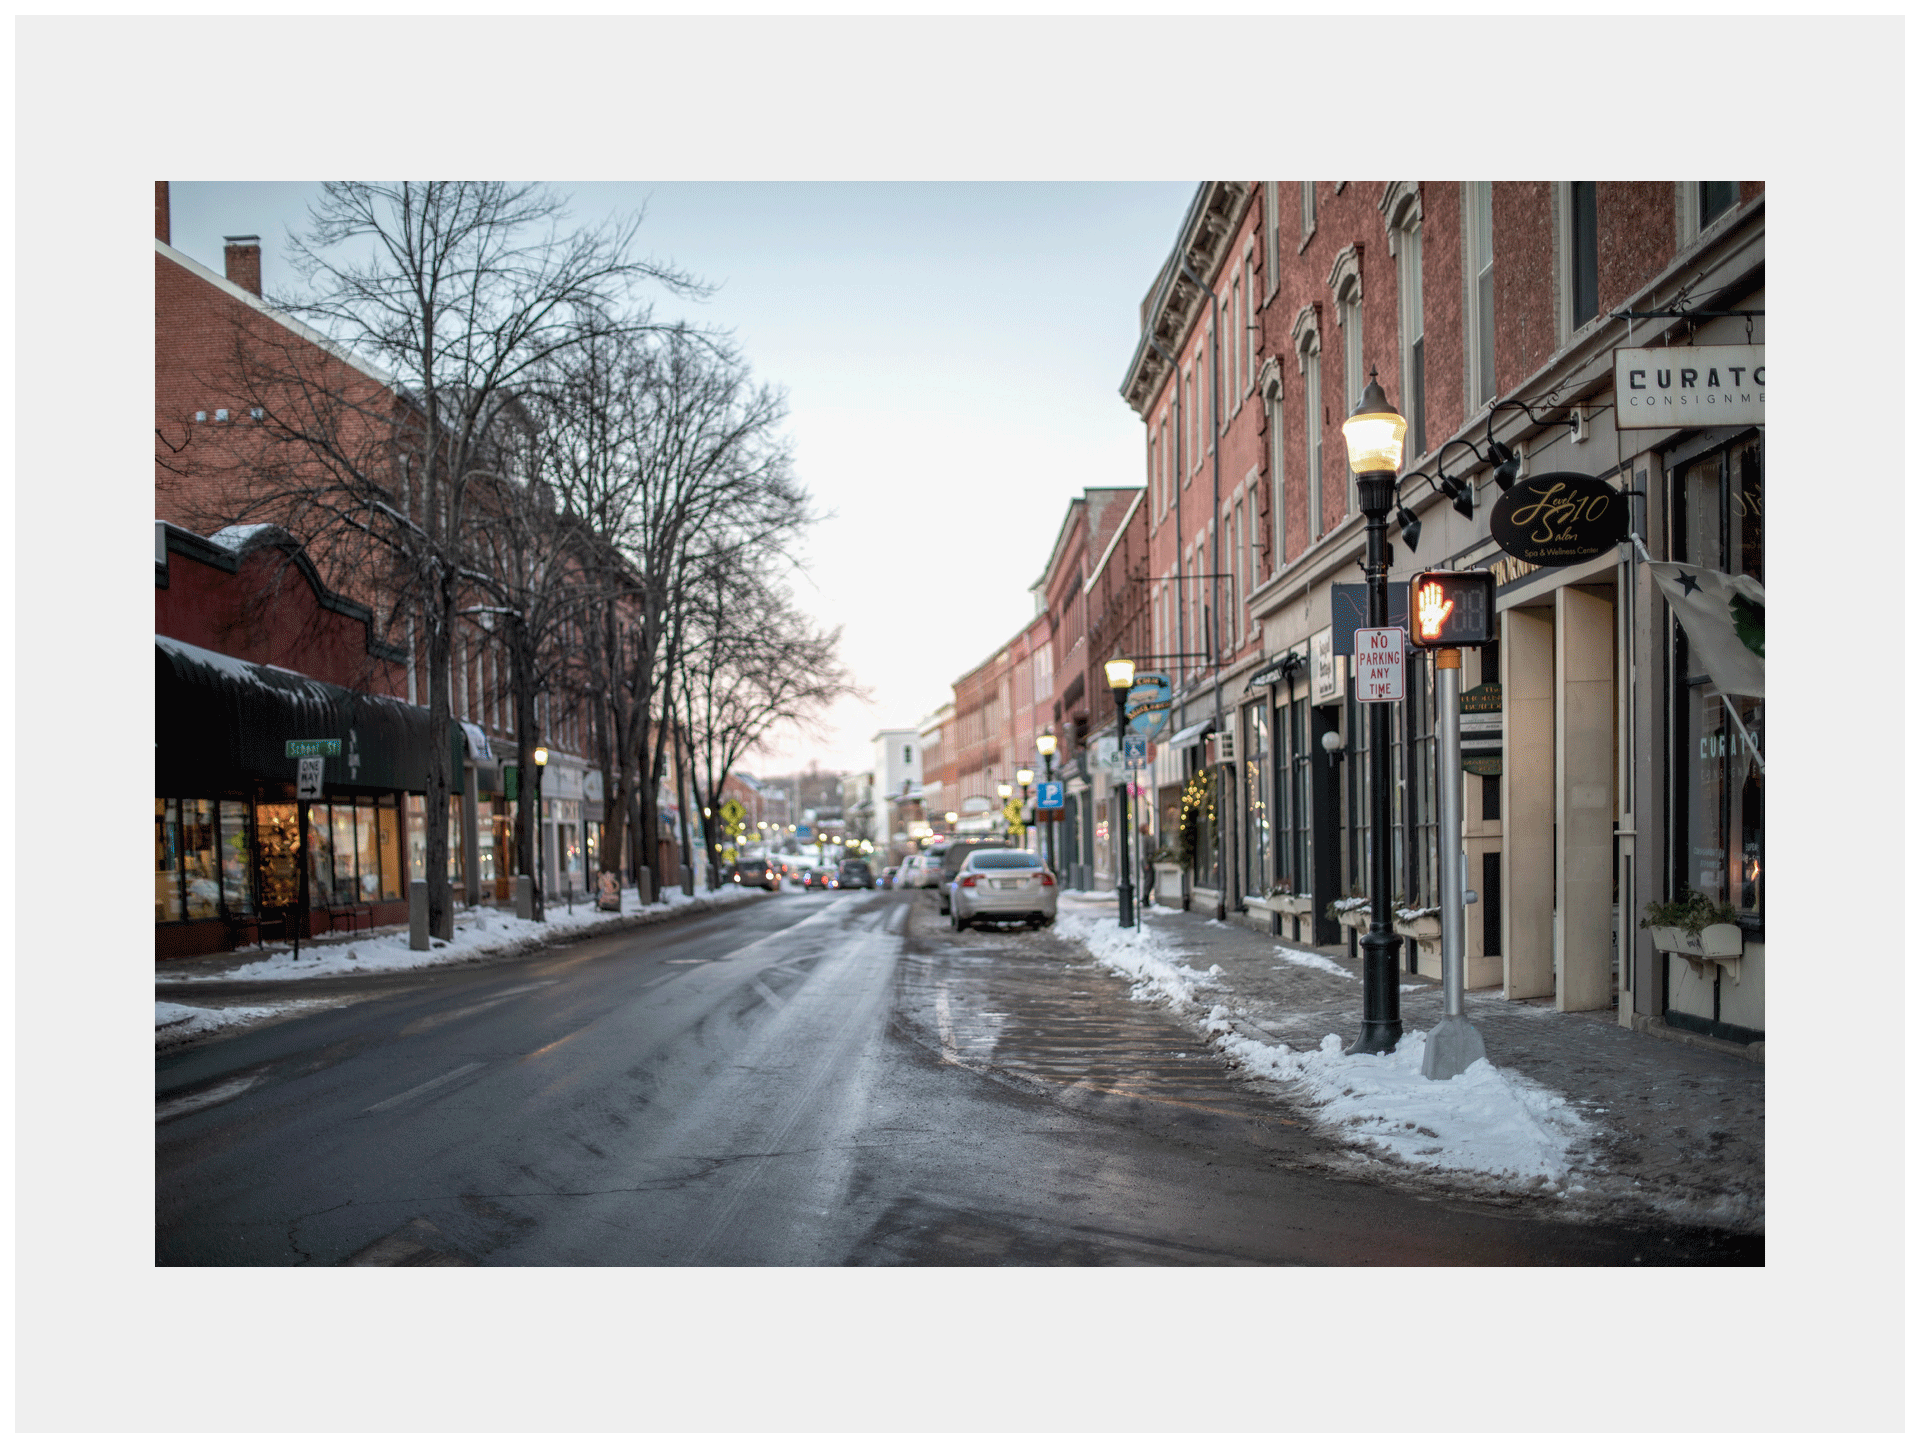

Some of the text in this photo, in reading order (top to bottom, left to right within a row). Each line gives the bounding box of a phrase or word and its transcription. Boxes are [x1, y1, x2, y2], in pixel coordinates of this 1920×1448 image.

[1629, 366, 1765, 390] CURATO
[1511, 482, 1610, 526] Level 10
[1531, 503, 1578, 543] Salon
[1524, 549, 1539, 558] Spa
[1546, 548, 1576, 556] Wellness
[1576, 546, 1599, 555] Center
[1370, 635, 1389, 649] NO
[1359, 651, 1400, 666] PARKING
[1370, 667, 1390, 679] ANY
[1369, 682, 1392, 695] TIME
[301, 760, 319, 771] ONE
[301, 772, 319, 783] WAY
